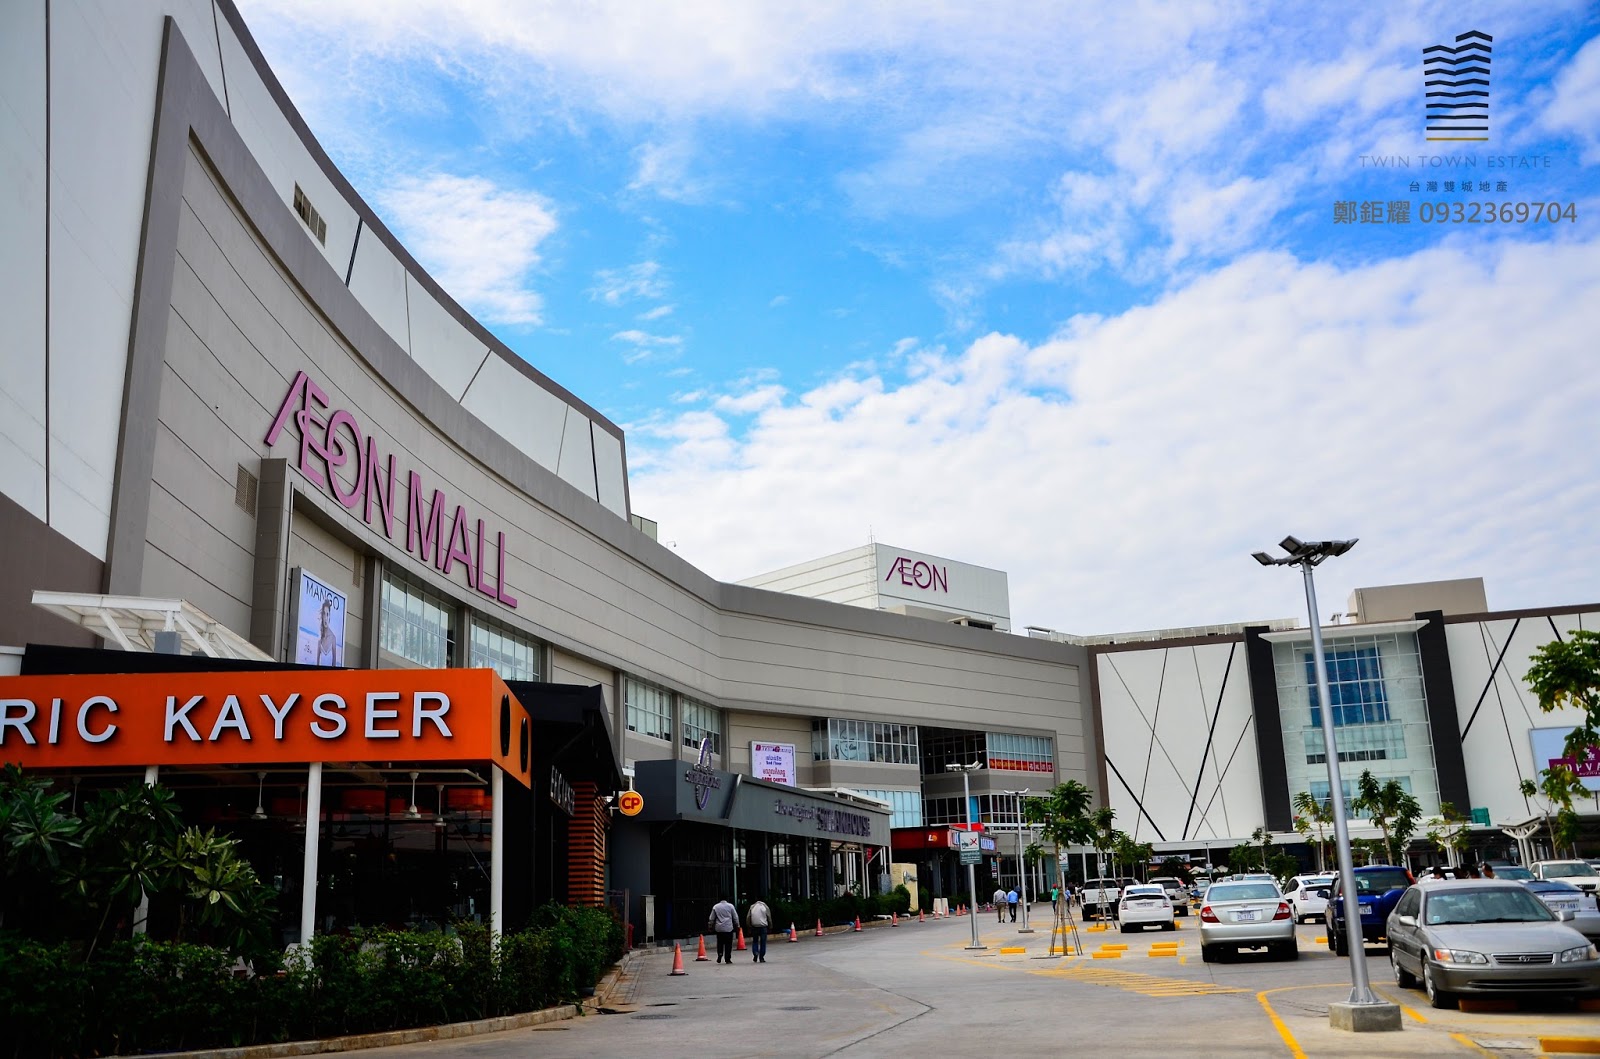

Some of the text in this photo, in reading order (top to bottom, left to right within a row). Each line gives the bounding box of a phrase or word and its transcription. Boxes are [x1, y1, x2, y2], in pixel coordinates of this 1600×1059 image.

[407, 470, 518, 608] MALL
[306, 580, 340, 611] MANGO
[0, 691, 454, 744] RIC KAYSER
[621, 797, 640, 809] CP
